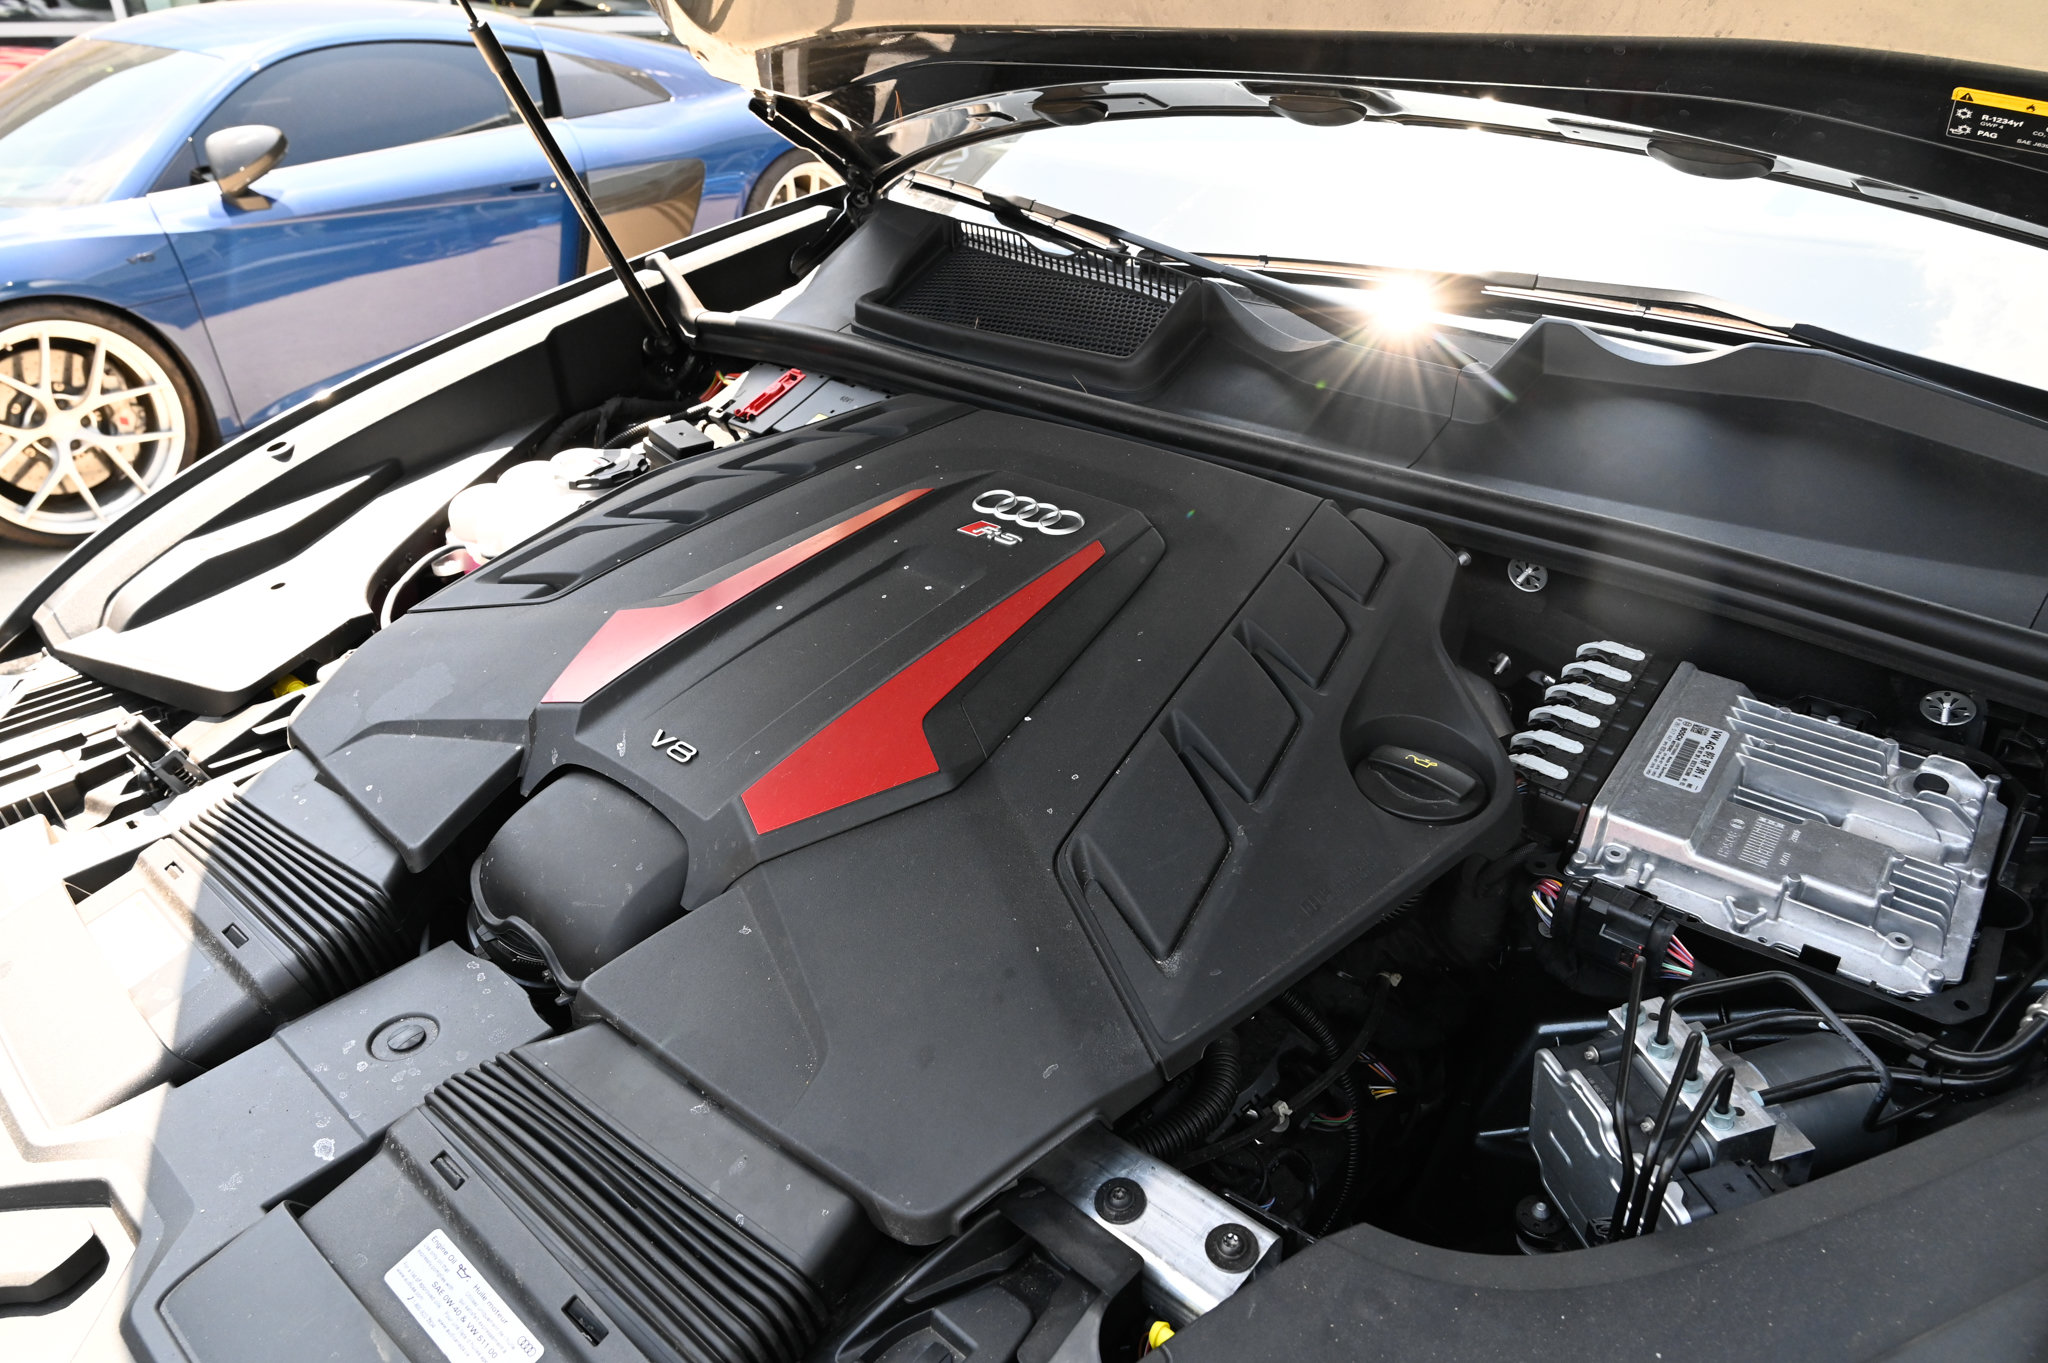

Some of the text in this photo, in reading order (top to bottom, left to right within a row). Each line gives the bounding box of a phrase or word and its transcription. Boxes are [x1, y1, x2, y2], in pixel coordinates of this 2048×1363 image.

[1980, 121, 1998, 129] GWP
[1981, 114, 2024, 128] R-1234yf
[1977, 130, 1998, 139] PAG
[962, 521, 1023, 546] RS
[651, 728, 698, 764] V8
[1705, 730, 1723, 751] VW AG
[431, 1235, 457, 1265] Engine Oil
[473, 1284, 509, 1324] Huile moteur
[431, 1281, 445, 1295] SAE
[466, 1322, 479, 1335] VW
[476, 1335, 489, 1350] 511
[487, 1347, 498, 1359] 00
